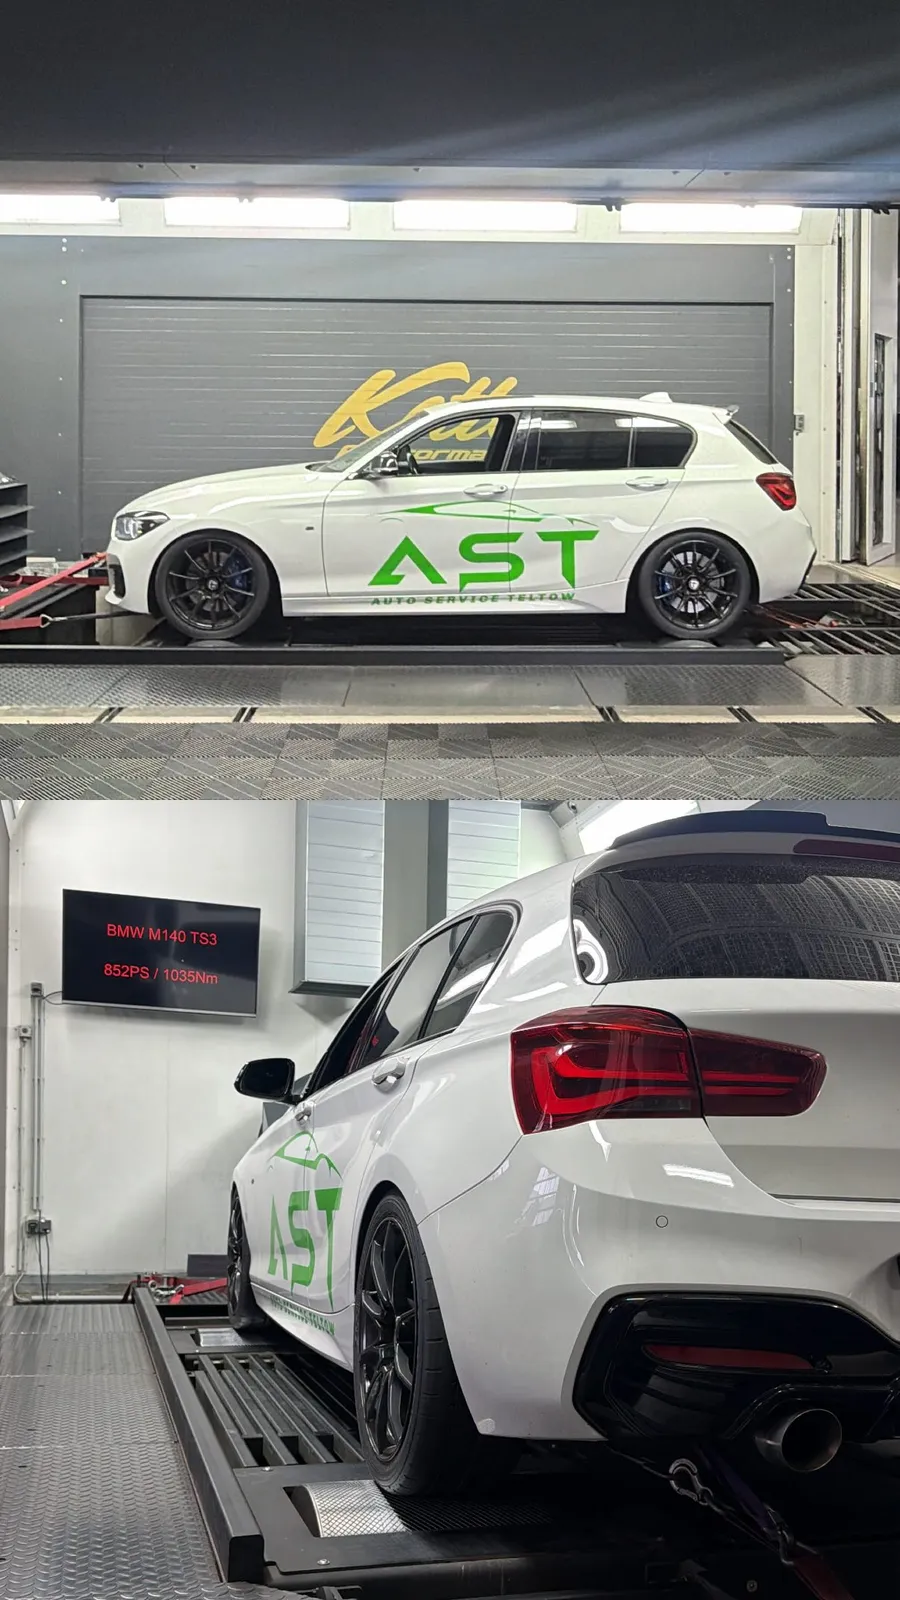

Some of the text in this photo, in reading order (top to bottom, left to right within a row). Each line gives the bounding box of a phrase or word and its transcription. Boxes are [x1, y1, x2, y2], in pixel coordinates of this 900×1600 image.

[368, 530, 600, 592] AST
[370, 592, 577, 606] AUTO SERVICE TELTOW
[106, 923, 218, 946] BMW M140 TS3
[103, 963, 218, 985] 852PS / 1035Nm
[267, 1187, 343, 1311] AST
